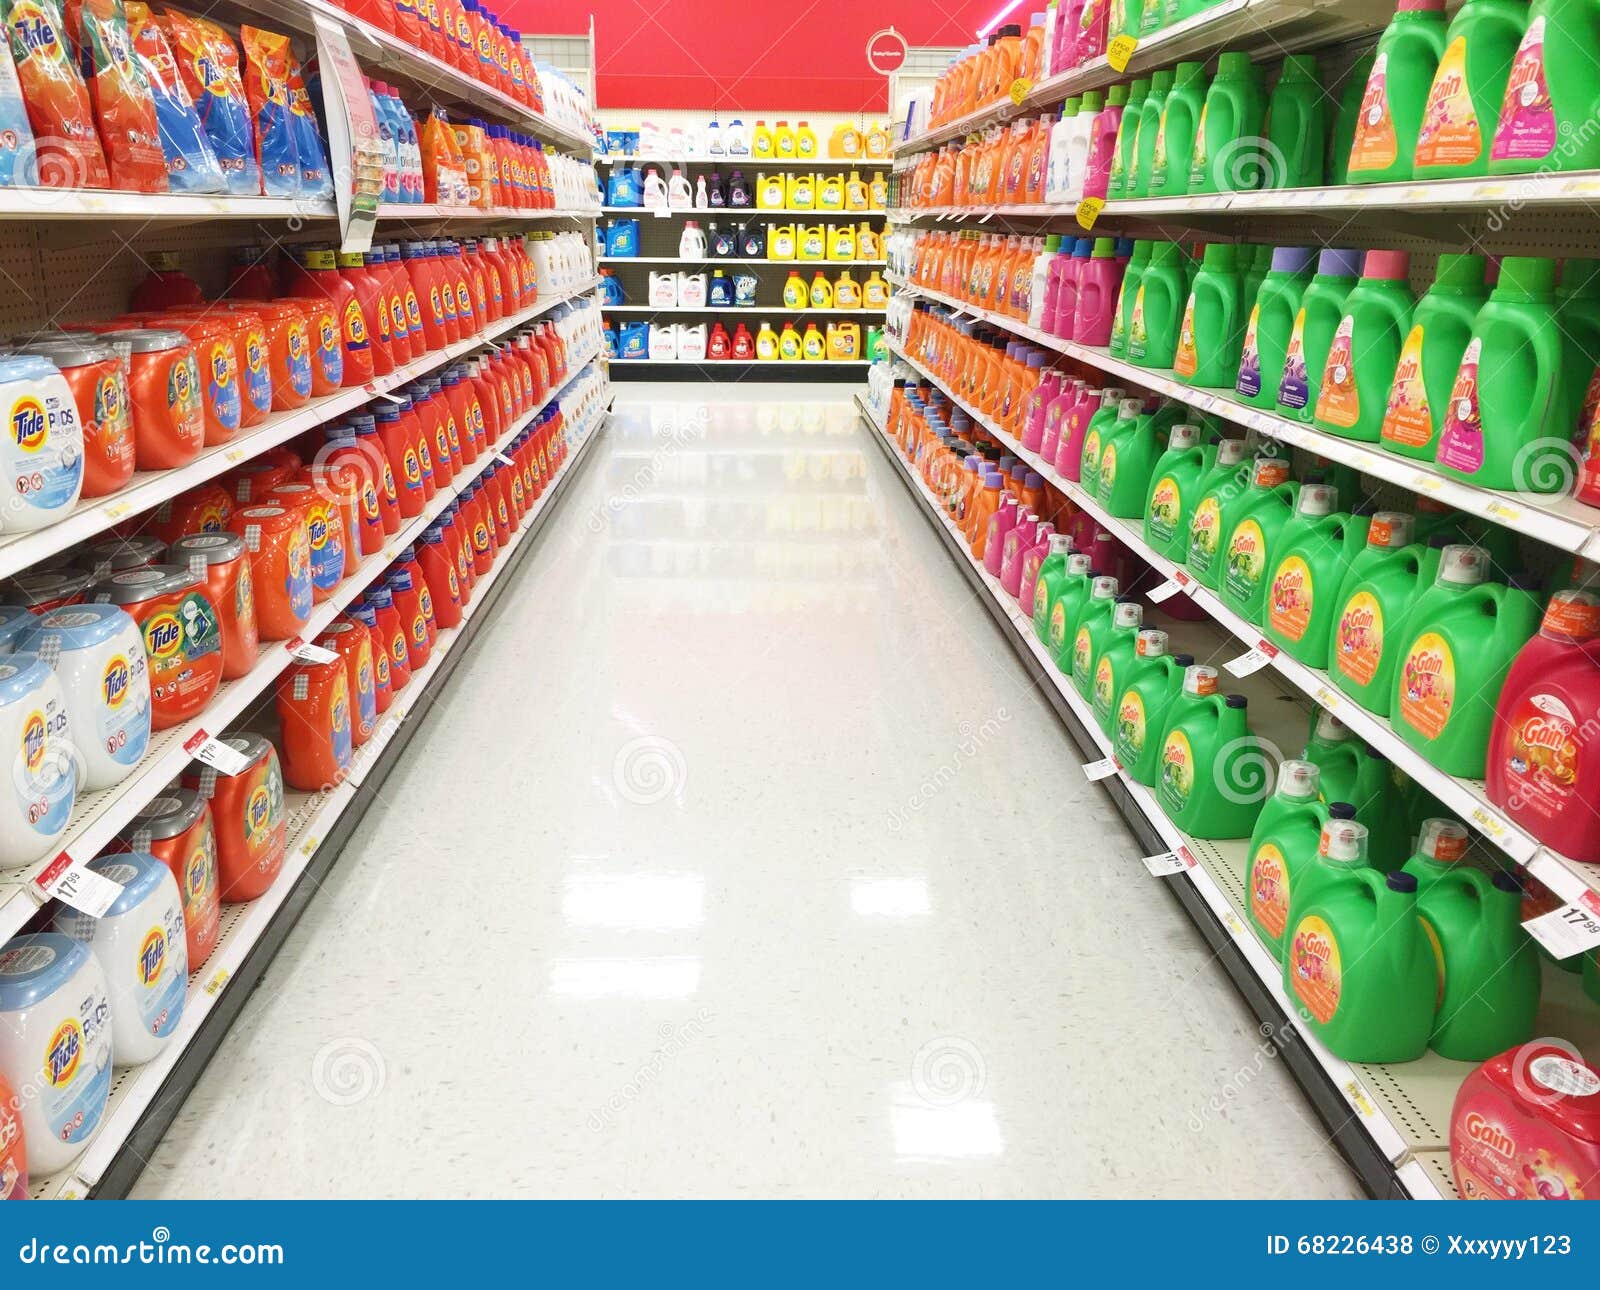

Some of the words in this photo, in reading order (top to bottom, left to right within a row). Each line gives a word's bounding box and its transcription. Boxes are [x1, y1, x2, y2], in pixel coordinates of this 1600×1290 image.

[15, 18, 55, 50] Tide
[214, 356, 227, 380] Tide
[13, 408, 44, 445] Tide
[309, 522, 327, 545] Tide
[1235, 535, 1256, 553] Gain
[1282, 571, 1303, 589] Gain
[1350, 607, 1374, 629] Gain
[149, 621, 180, 655] Tide
[1415, 650, 1442, 674] Gain
[105, 668, 128, 705] Tide
[24, 725, 44, 768] Tide
[1524, 717, 1565, 751] Gain
[1167, 744, 1186, 766] Gain
[252, 799, 268, 826] Tide
[1261, 858, 1282, 882] Gain
[1304, 932, 1331, 961] Gain
[141, 939, 165, 984] Tide
[48, 1030, 79, 1086] Tide
[1465, 1111, 1516, 1159] Gain
